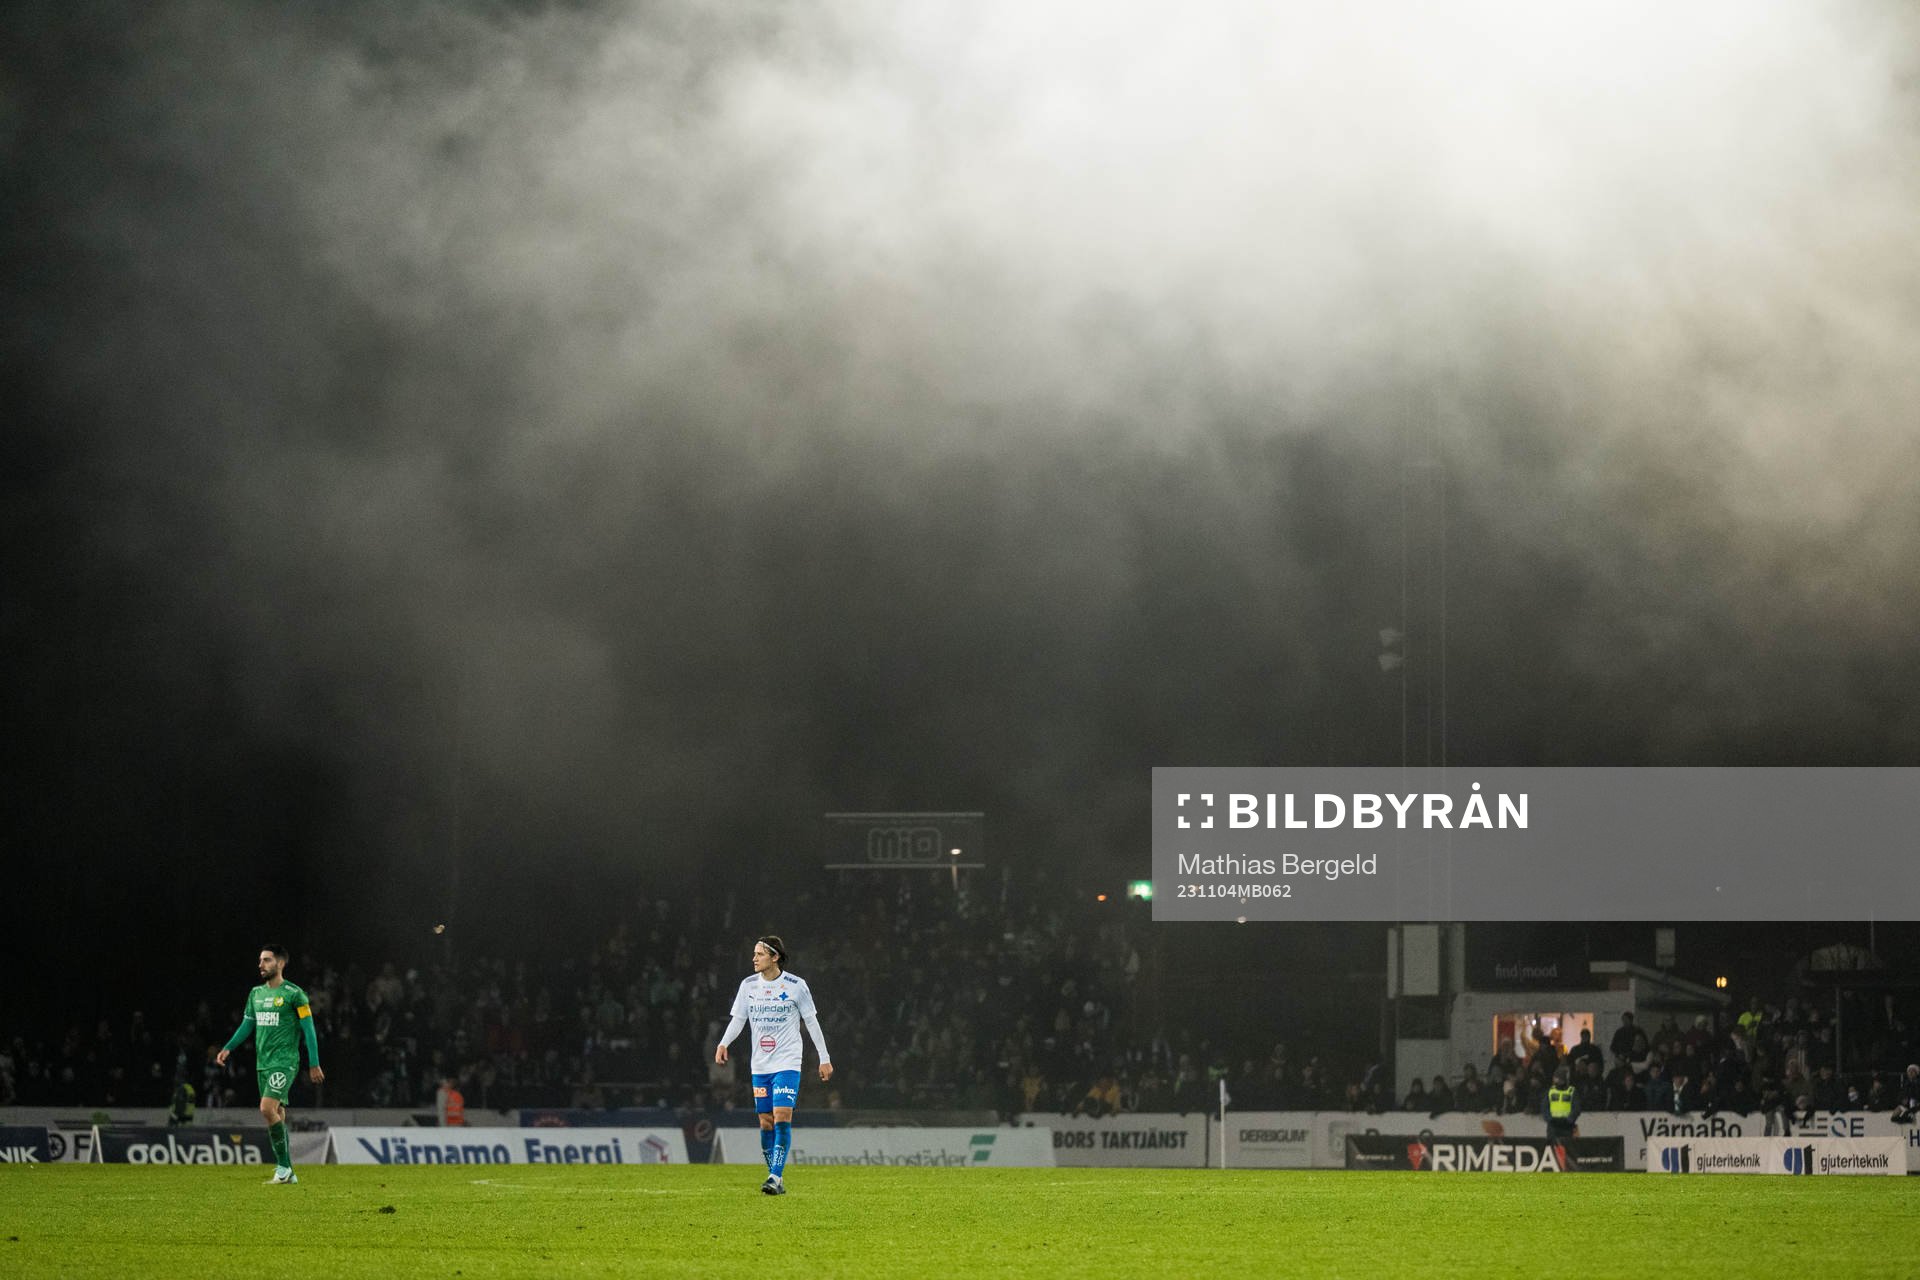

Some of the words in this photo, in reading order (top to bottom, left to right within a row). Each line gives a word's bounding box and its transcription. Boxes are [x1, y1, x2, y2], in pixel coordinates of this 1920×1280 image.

[1053, 1131, 1096, 1149] BORS
[1101, 1127, 1188, 1149] TAKTJÄNST
[1639, 1117, 1742, 1138] VärnaBo
[126, 1134, 263, 1165] golvabia
[357, 1137, 511, 1165] Värnamo
[524, 1137, 623, 1165] Energi
[1432, 1144, 1560, 1172] RIMEDA
[1696, 1154, 1761, 1174] gjuteriteknik
[1820, 1153, 1889, 1175] gjuteriteknik
